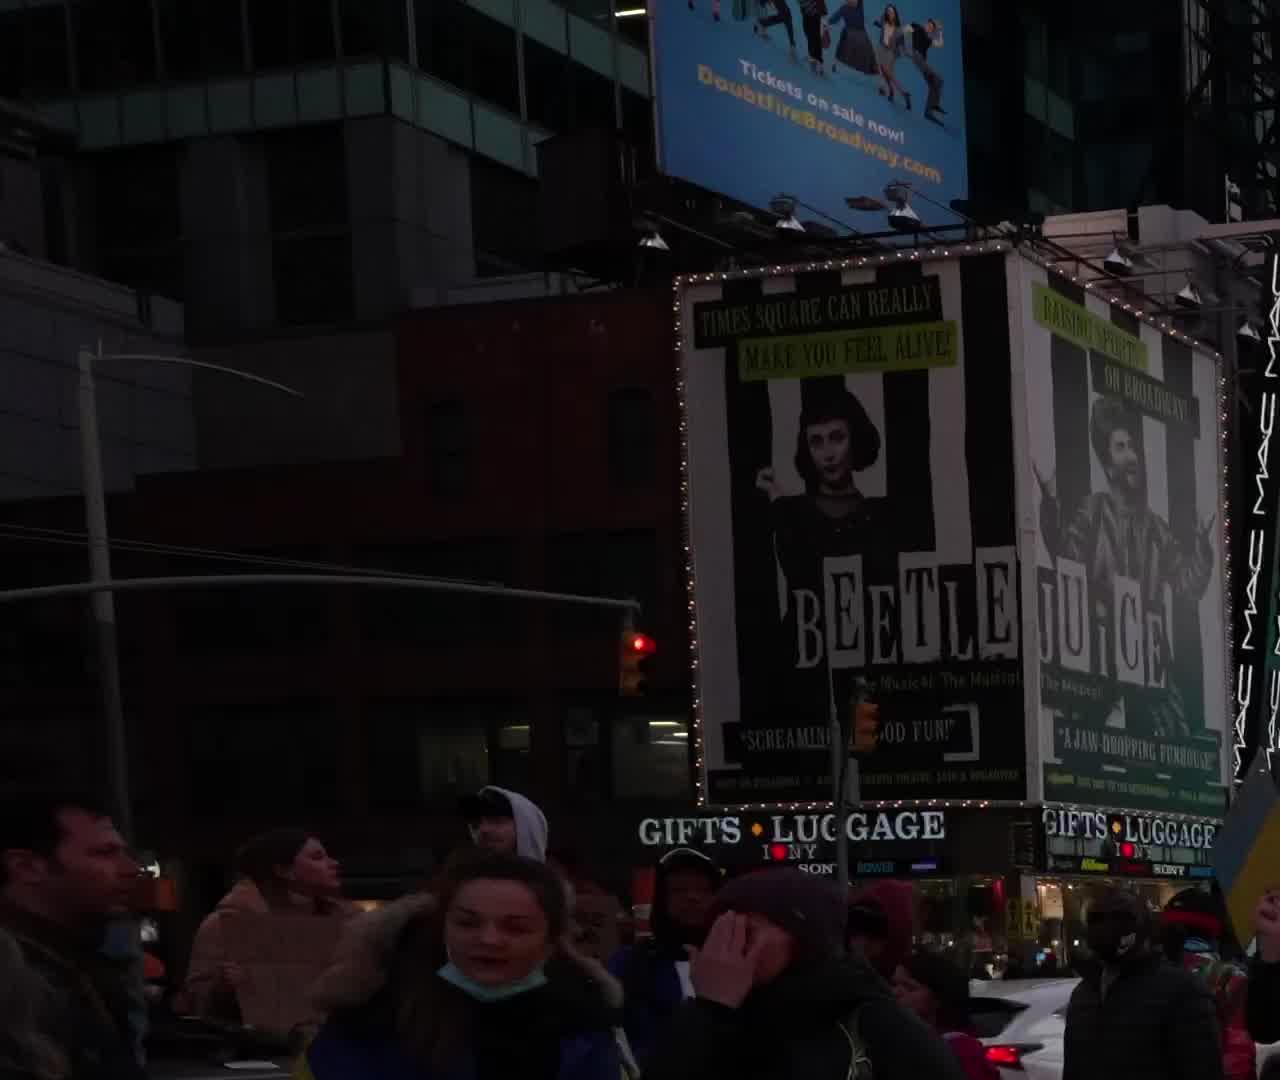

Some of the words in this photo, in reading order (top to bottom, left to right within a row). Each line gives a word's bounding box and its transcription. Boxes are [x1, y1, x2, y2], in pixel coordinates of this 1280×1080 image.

[738, 57, 802, 101] Tickets
[807, 91, 830, 111] on
[832, 99, 864, 128] sale
[868, 116, 905, 145] now!
[696, 63, 943, 185] DoubtfireBroadway.com
[744, 344, 795, 370] MAKE
[802, 340, 838, 368] YOU
[639, 816, 742, 845] GIFTS
[771, 810, 946, 843] LUGGAGE
[1042, 807, 1108, 840] GIFTS
[1124, 815, 1216, 849] LUGGAGE
[797, 863, 838, 875] SON
